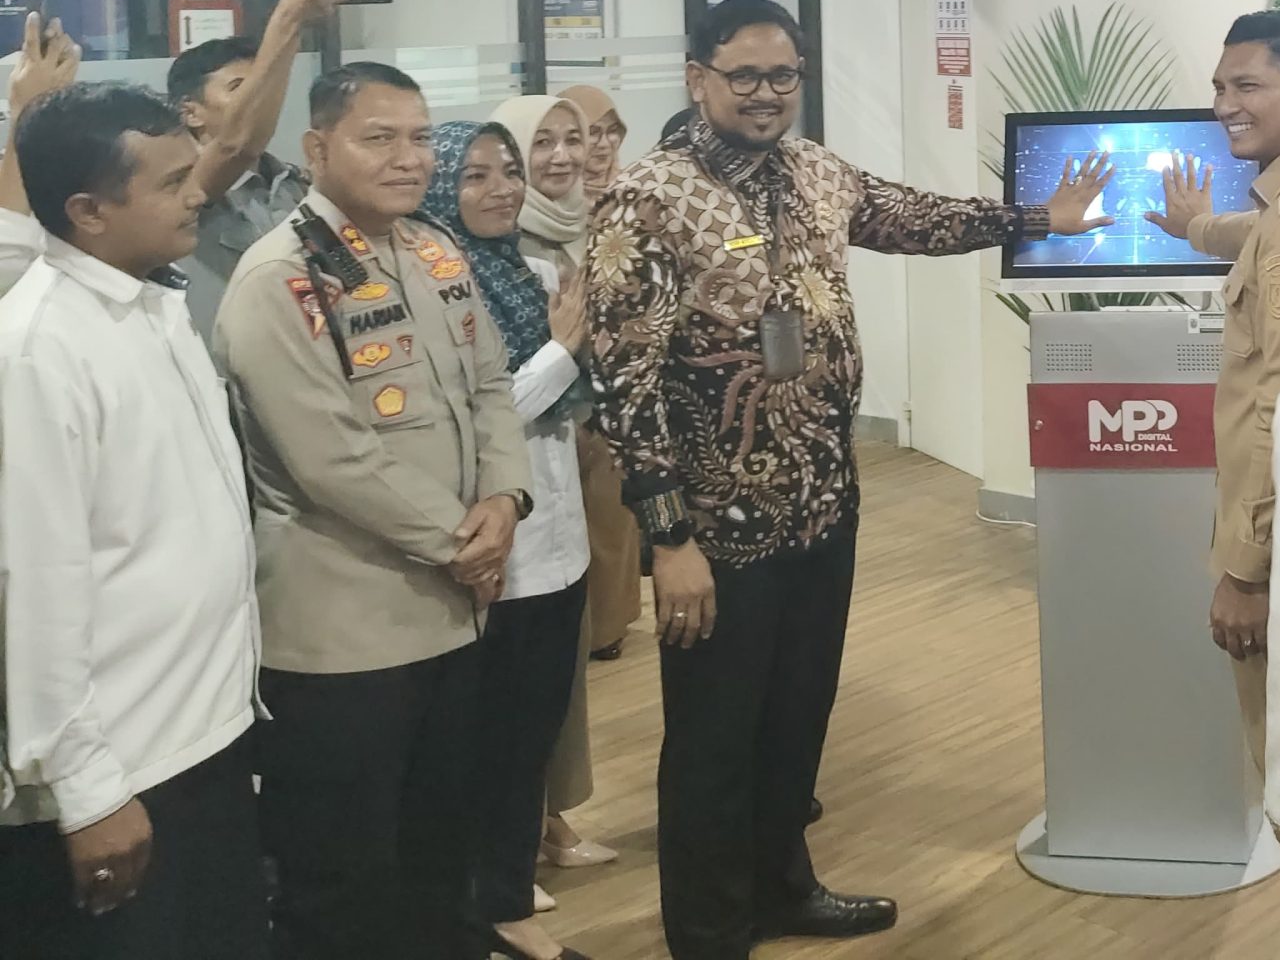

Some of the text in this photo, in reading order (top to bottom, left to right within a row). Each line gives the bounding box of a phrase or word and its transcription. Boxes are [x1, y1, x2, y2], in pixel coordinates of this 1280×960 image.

[1087, 399, 1178, 444] MPP
[1138, 433, 1173, 442] DIGITAL
[1089, 443, 1178, 453] NASIONAL
